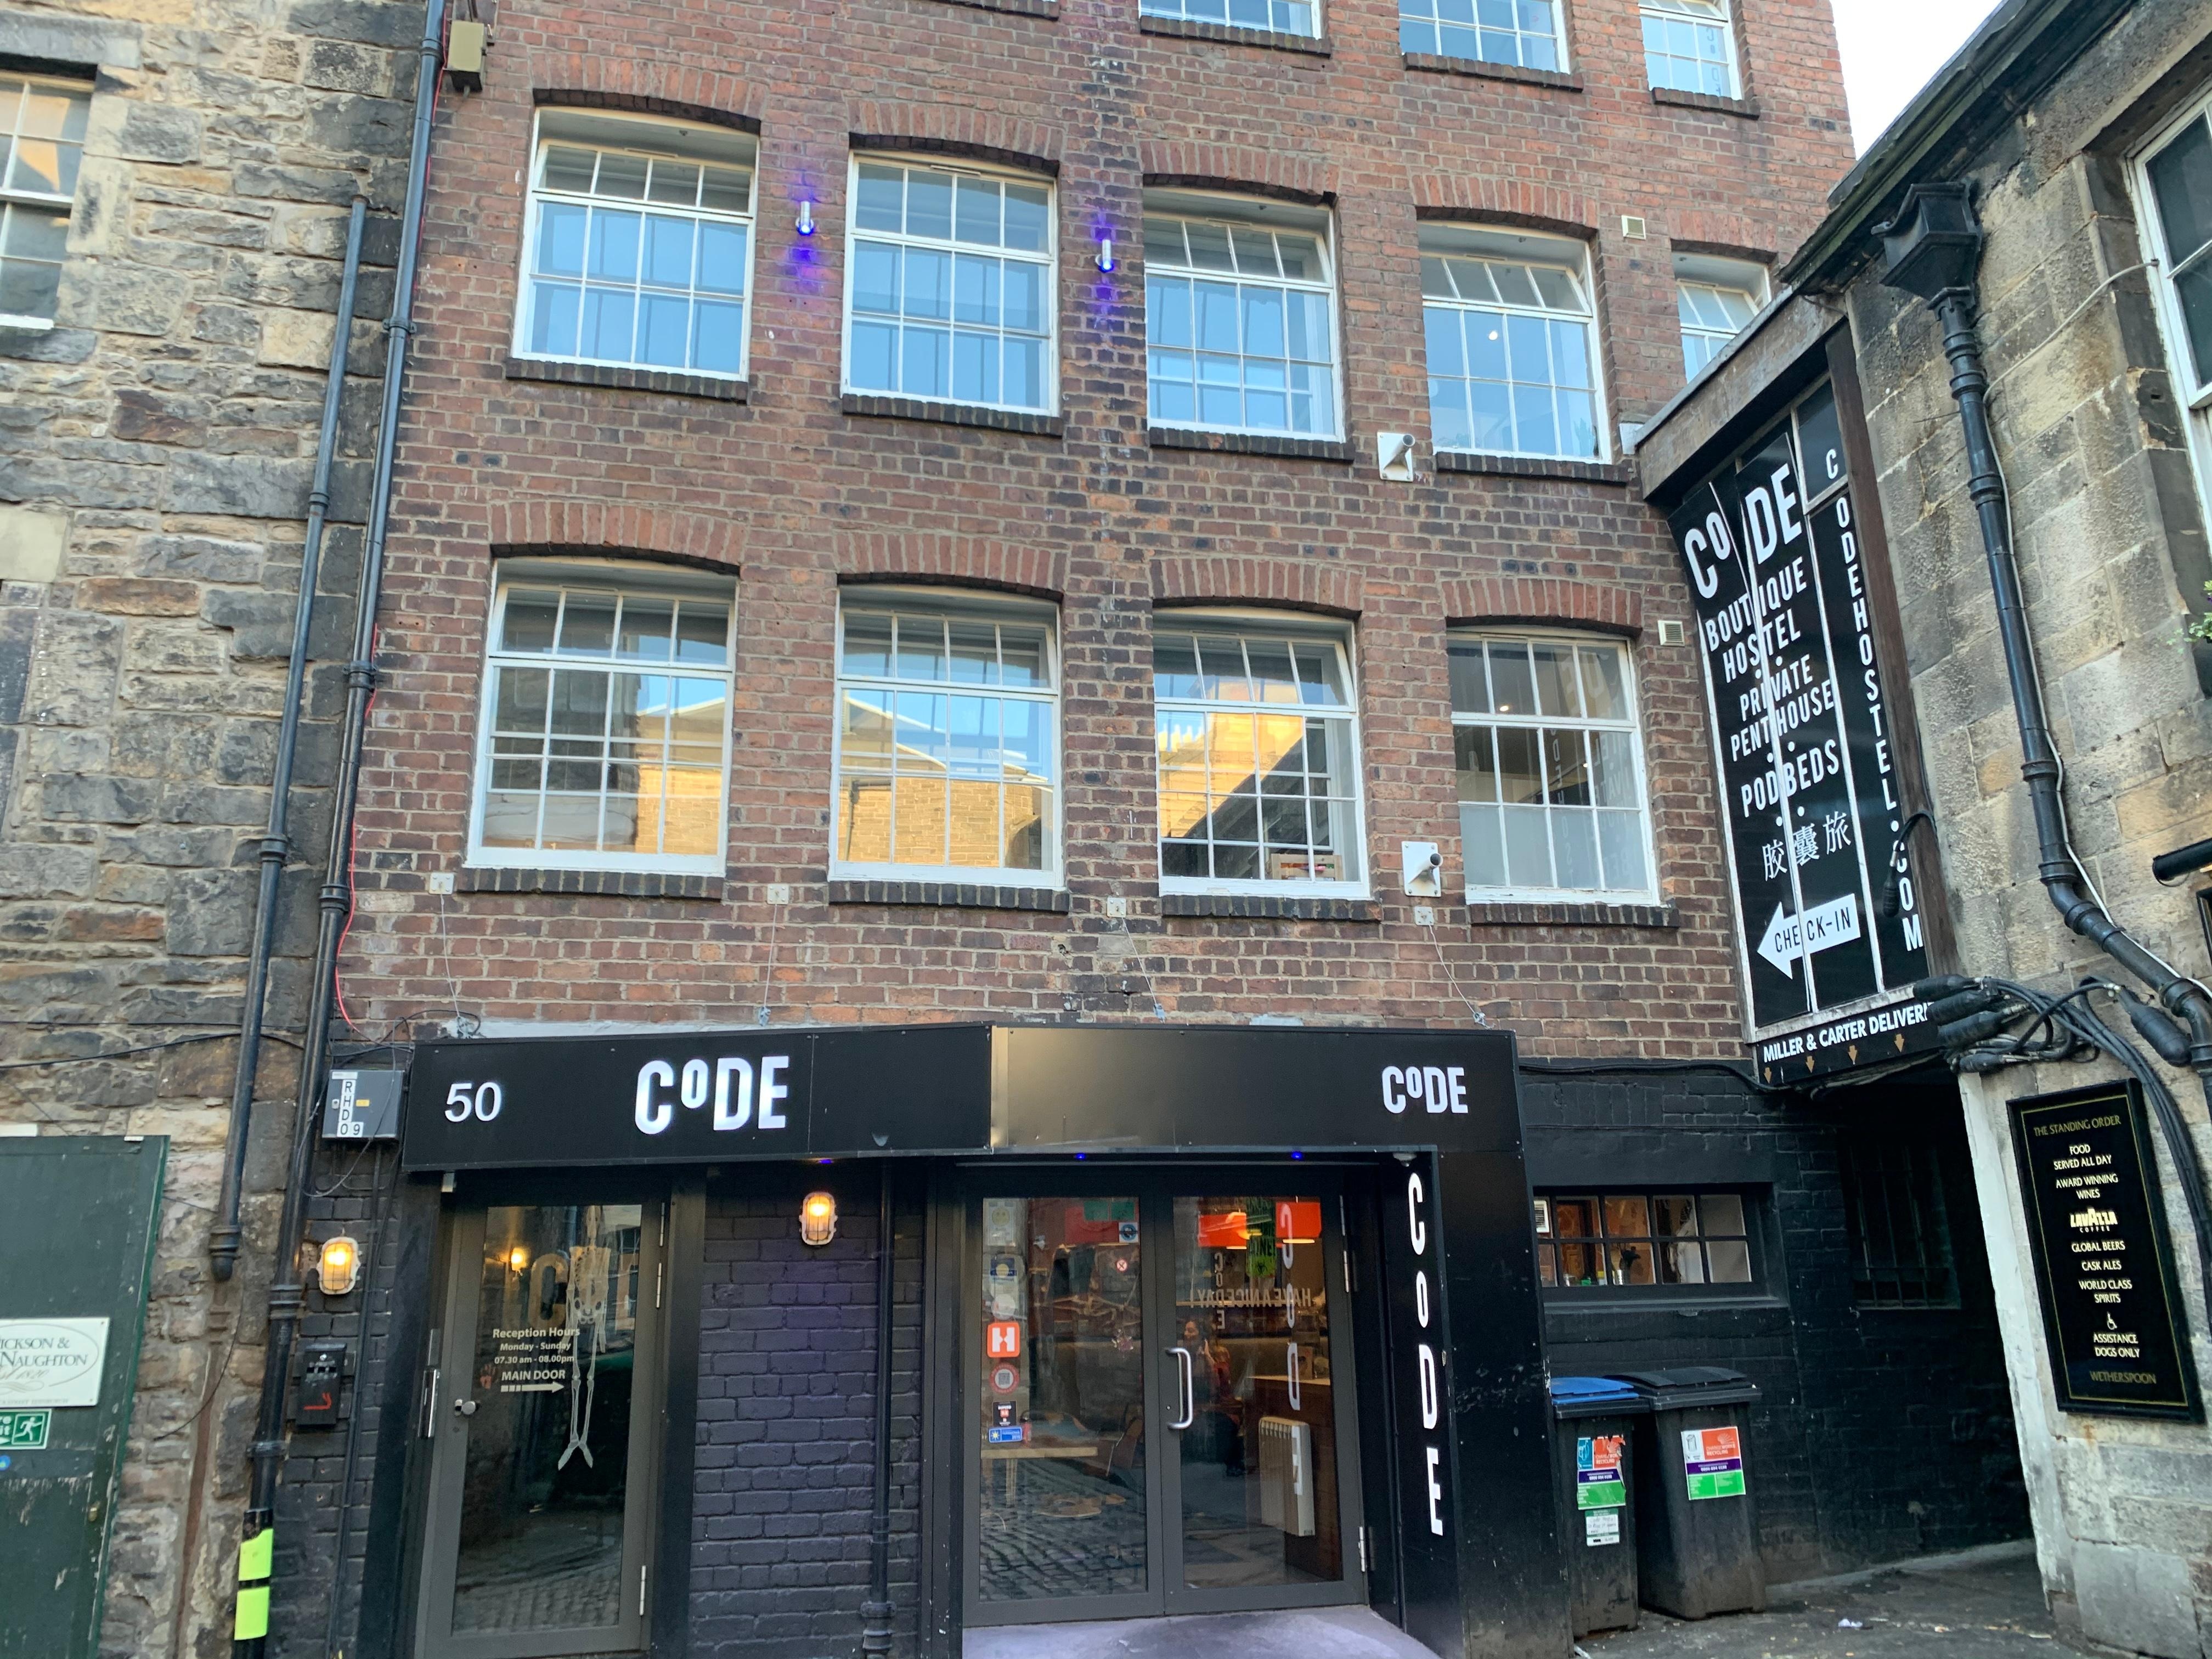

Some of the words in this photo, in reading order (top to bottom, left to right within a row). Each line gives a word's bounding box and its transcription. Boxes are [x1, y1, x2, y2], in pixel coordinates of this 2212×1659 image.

[1705, 556, 1807, 652] BOUTIQUE
[1723, 608, 1801, 683] HOSTEL
[1740, 654, 1813, 721] PRIVATE
[1731, 679, 1835, 761] PENTHOUSE
[1775, 907, 1851, 953] CHECK-IN
[1763, 1036, 1804, 1063] MILLER
[1806, 1034, 1818, 1051] &
[1819, 1019, 1867, 1047] CARTER
[635, 1055, 789, 1135] CODE
[1382, 1065, 1468, 1114] CODE
[445, 1082, 502, 1122] 50
[2034, 1126, 2048, 1136] THE
[2050, 1119, 2091, 1135] STANDING
[2091, 1115, 2121, 1128] ORDER
[2069, 1144, 2091, 1155] FOOD
[2053, 1159, 2079, 1170] SERVED
[2081, 1156, 2095, 1167] ALL
[2096, 1155, 2112, 1165] DAY
[2056, 1177, 2083, 1188] AWARD
[2084, 1173, 2119, 1185] WINNING
[2076, 1188, 2101, 1199] WINES
[2070, 1207, 2118, 1227] LAVAZZA
[2072, 1242, 2102, 1252] GLOBAL
[2102, 1240, 2126, 1251] BEERS
[2081, 1261, 2102, 1271] CASK
[2103, 1260, 2122, 1270] ALES
[2079, 1280, 2107, 1290] WORLD
[2108, 1279, 2132, 1289] CLASS
[2094, 1293, 2121, 1304] SPIRITS
[493, 1328, 546, 1339] Reception
[549, 1327, 580, 1337] Hours
[2094, 1333, 2138, 1344] ASSISTANCE
[57, 1338, 70, 1349] &
[500, 1342, 534, 1352] Monday
[540, 1342, 571, 1351] Sunday
[2095, 1347, 2117, 1357] DOGS
[2118, 1347, 2140, 1358] ONLY
[494, 1356, 518, 1364] 07.30
[501, 1371, 531, 1381] MAIN
[533, 1370, 566, 1380] DOOR
[2090, 1370, 2157, 1384] WETHERSPOON
